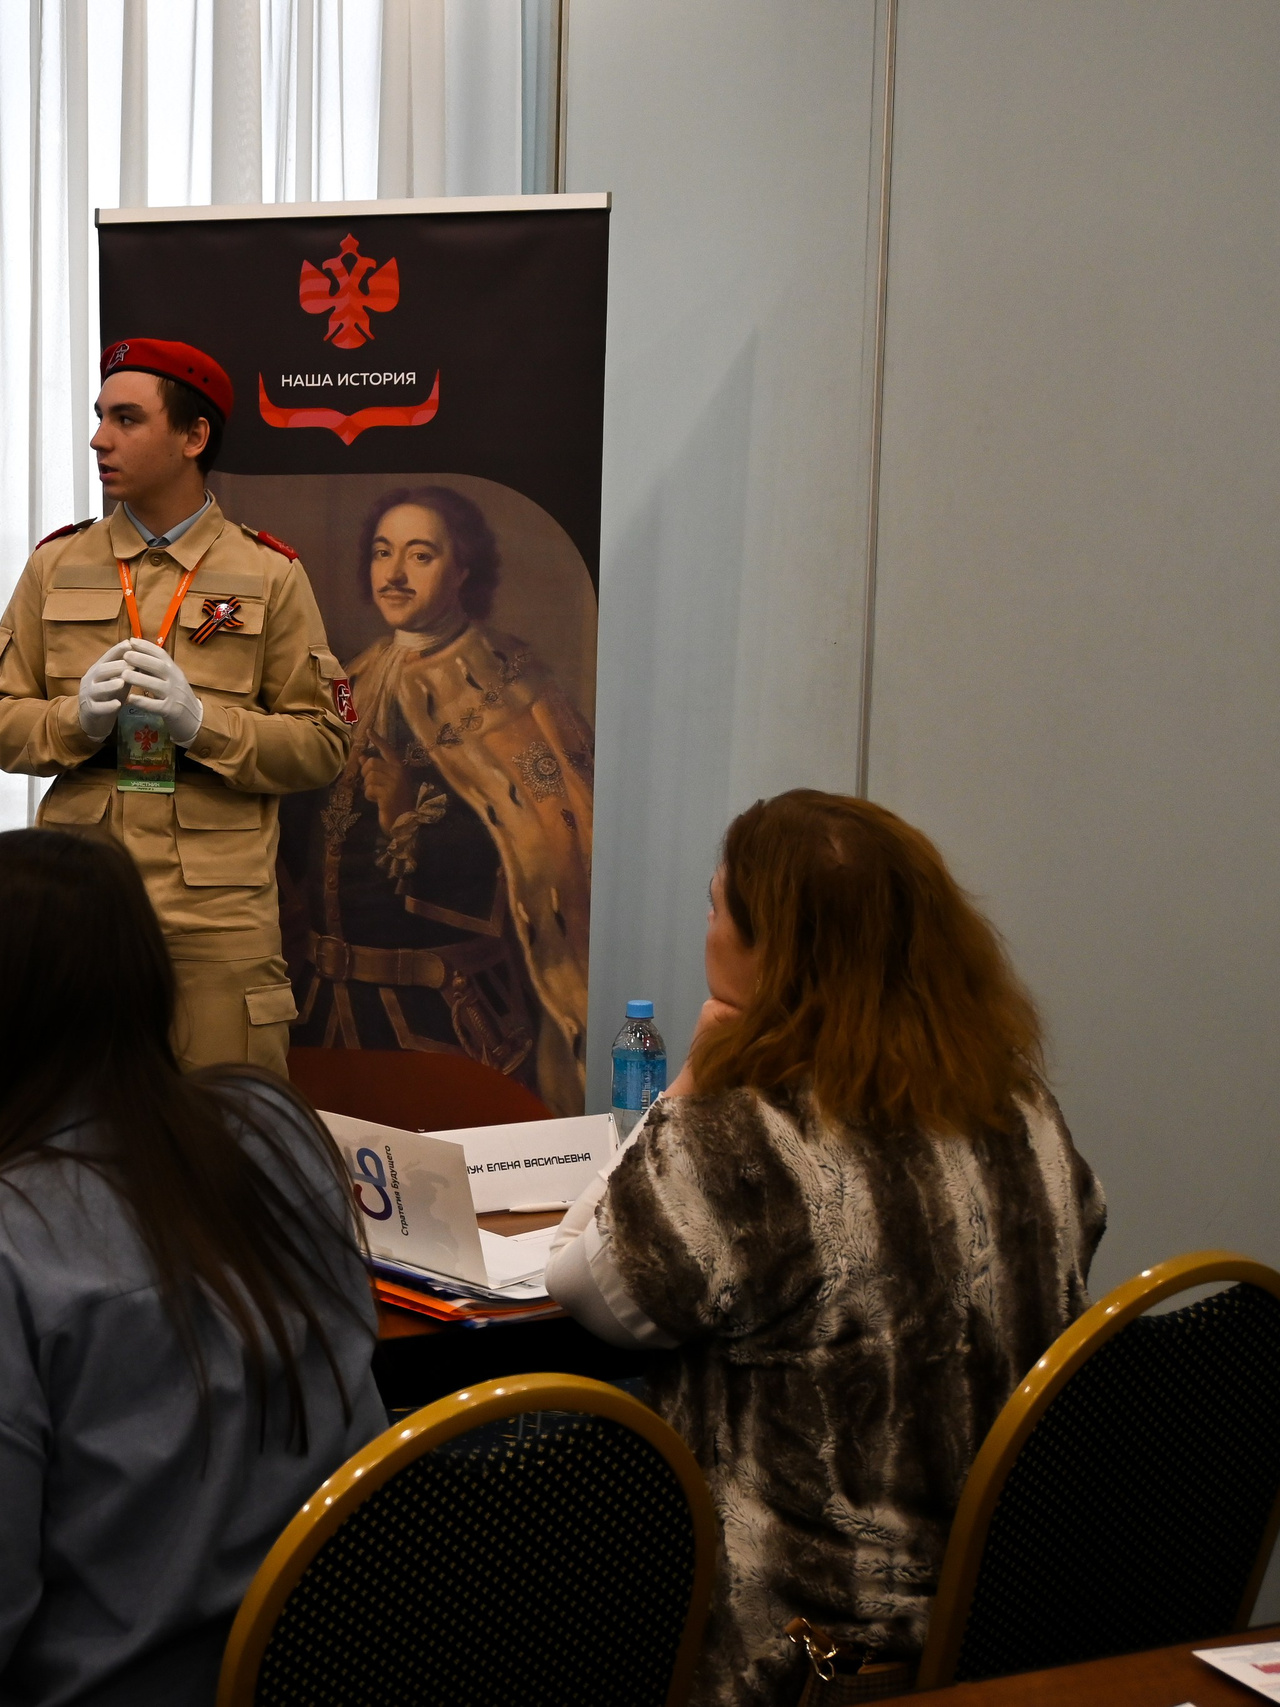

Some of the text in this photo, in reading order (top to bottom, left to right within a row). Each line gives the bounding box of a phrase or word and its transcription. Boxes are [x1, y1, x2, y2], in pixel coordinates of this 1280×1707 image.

[281, 372, 416, 387] НАША ИСТОРИЯ
[486, 1160, 521, 1172] ЕЛЕНА
[524, 1152, 591, 1168] ВАСИЛЬЕВНА
[384, 1145, 409, 1236] Стратегия Будущего
